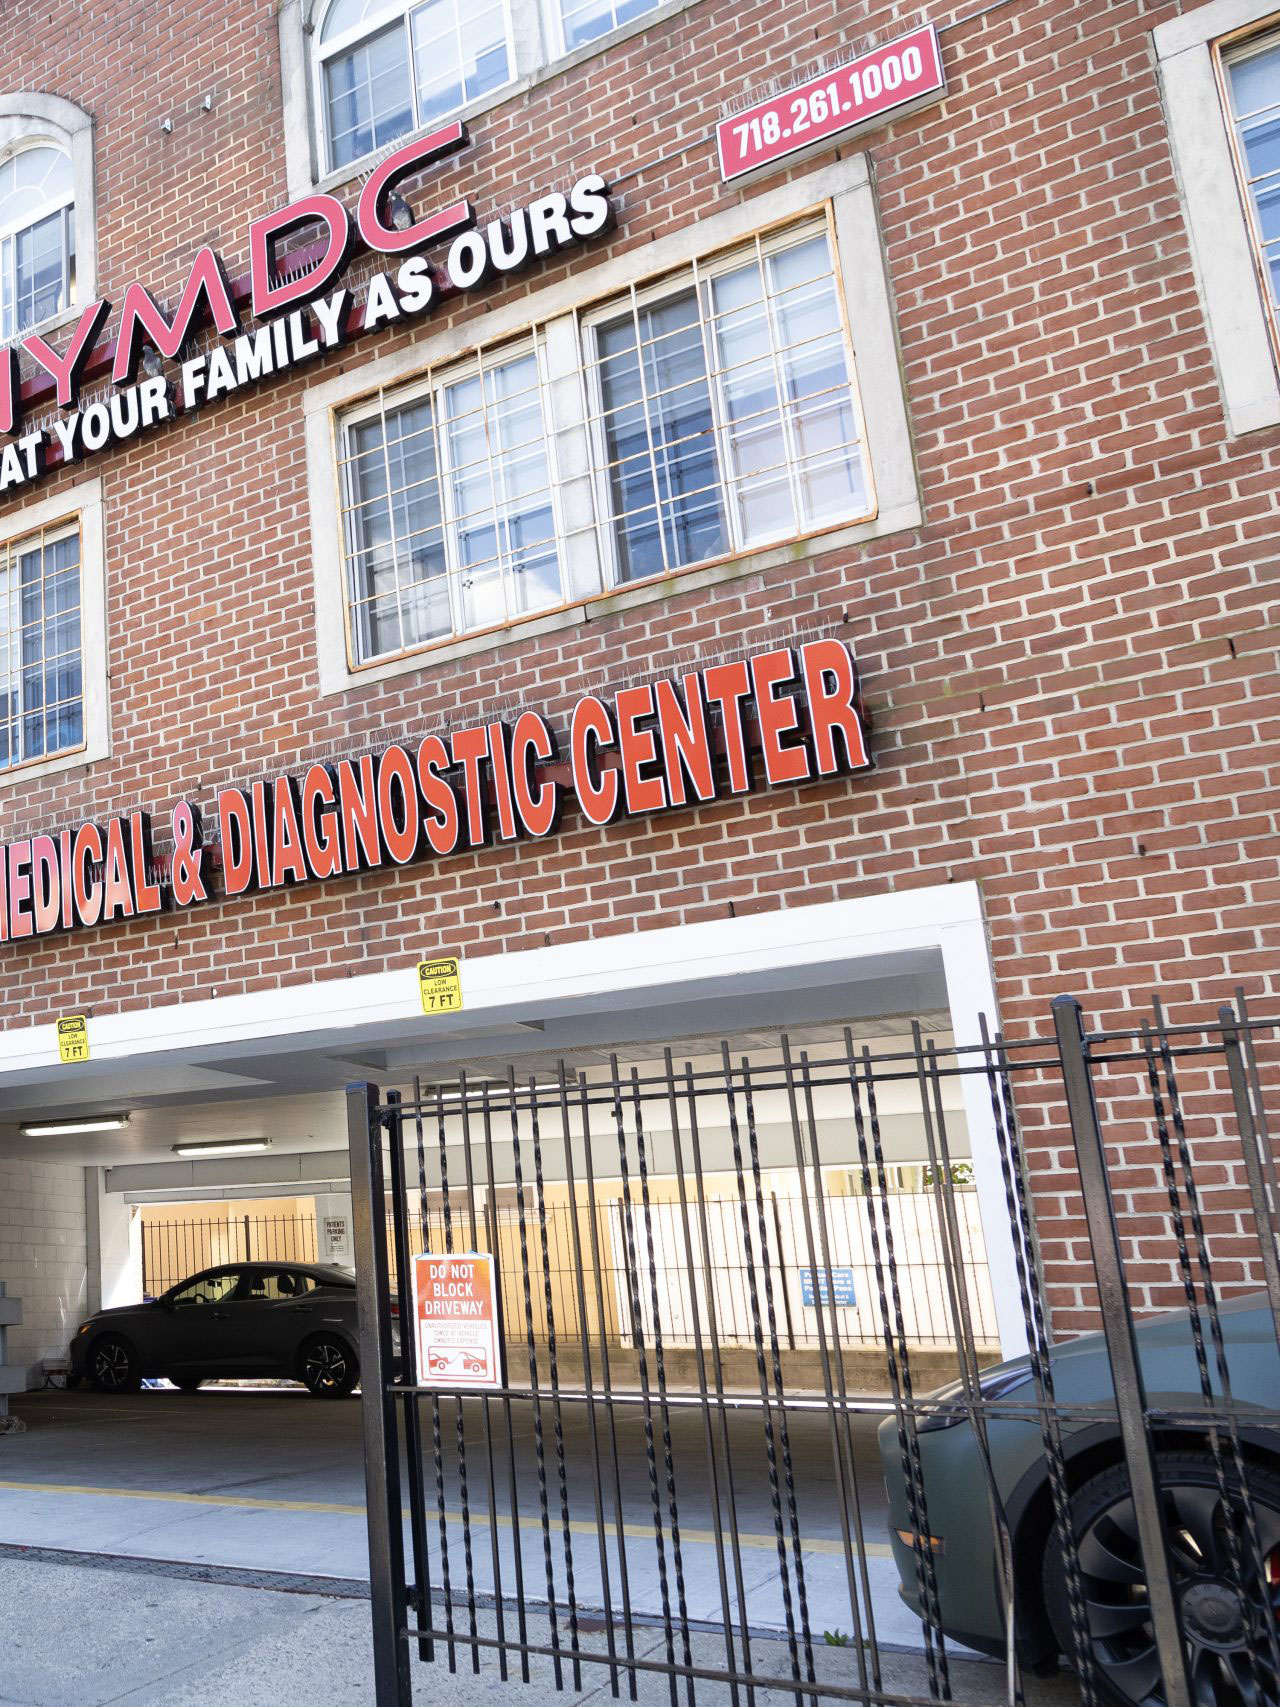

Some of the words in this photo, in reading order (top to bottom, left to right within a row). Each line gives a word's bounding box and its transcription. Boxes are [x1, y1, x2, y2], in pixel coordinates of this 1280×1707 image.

[732, 45, 923, 158] 718.261.1000
[53, 375, 170, 462] YOUR
[181, 288, 348, 409] FAMILY
[364, 256, 433, 330] AS
[447, 173, 608, 289] OURS
[171, 799, 208, 906] &
[219, 710, 558, 897] DIAGNOSTIC
[571, 638, 870, 826] CENTER
[425, 964, 451, 976] CAUTION
[424, 985, 457, 995] CLEARANCE
[429, 996, 435, 1008] 7
[440, 994, 453, 1006] FT
[61, 1039, 85, 1047] CLEARANCE
[65, 1048, 69, 1057] 7
[73, 1046, 82, 1056] FT
[430, 1264, 447, 1278] DO
[451, 1264, 474, 1278] NOT
[433, 1283, 473, 1297] BLOCK
[425, 1301, 483, 1315] DRIVEWAY
